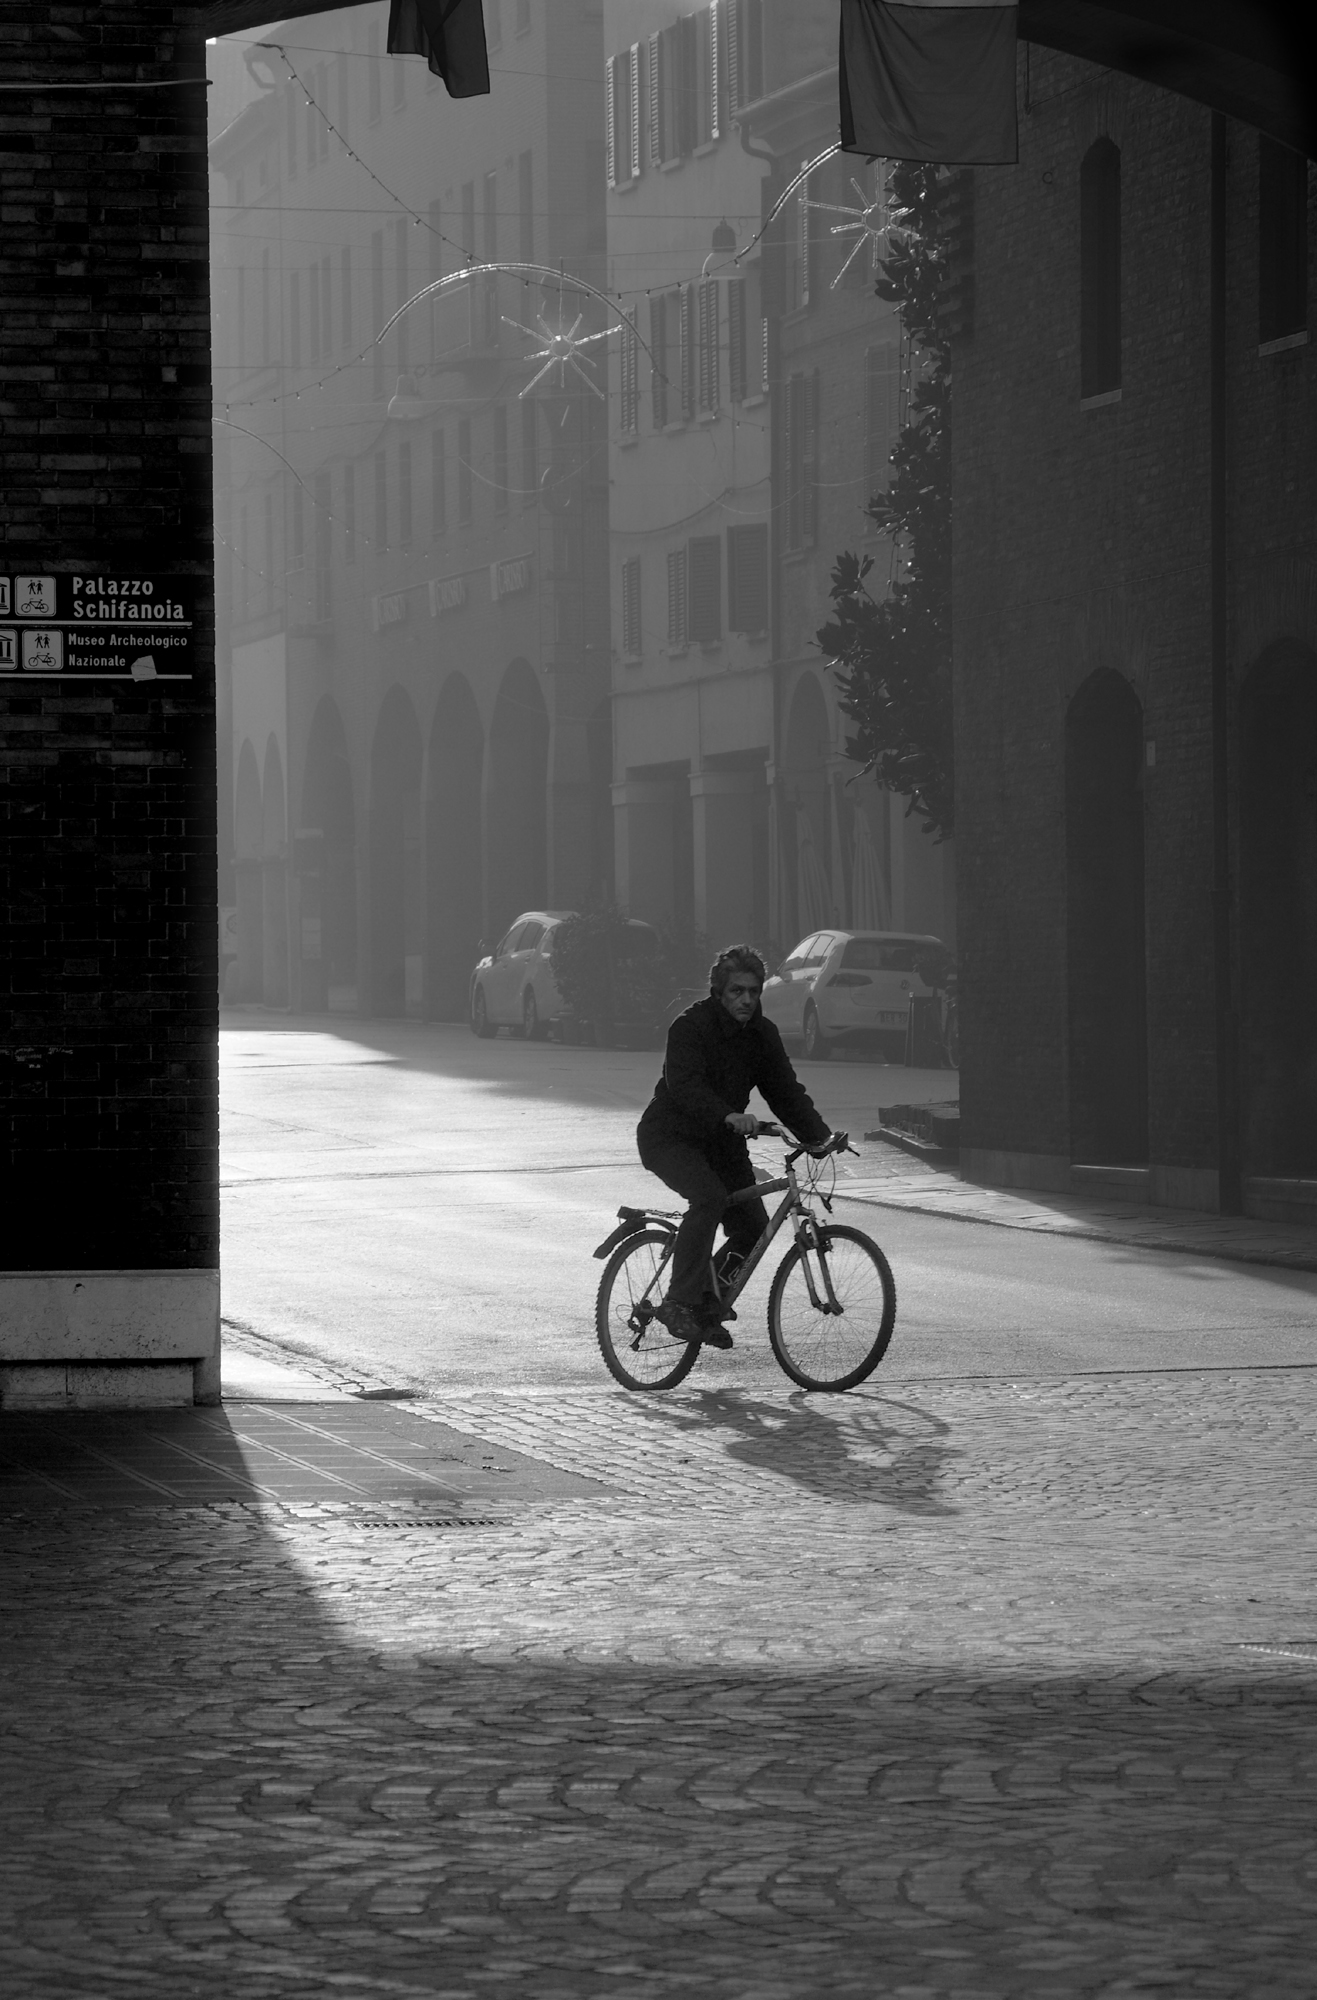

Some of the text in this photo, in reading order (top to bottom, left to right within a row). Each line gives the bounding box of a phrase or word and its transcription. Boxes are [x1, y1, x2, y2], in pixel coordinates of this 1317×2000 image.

[73, 576, 154, 596] Palazzo
[73, 599, 185, 619] Schifanoia
[68, 633, 188, 649] Museo Archeologico
[68, 654, 126, 667] Nazionale
